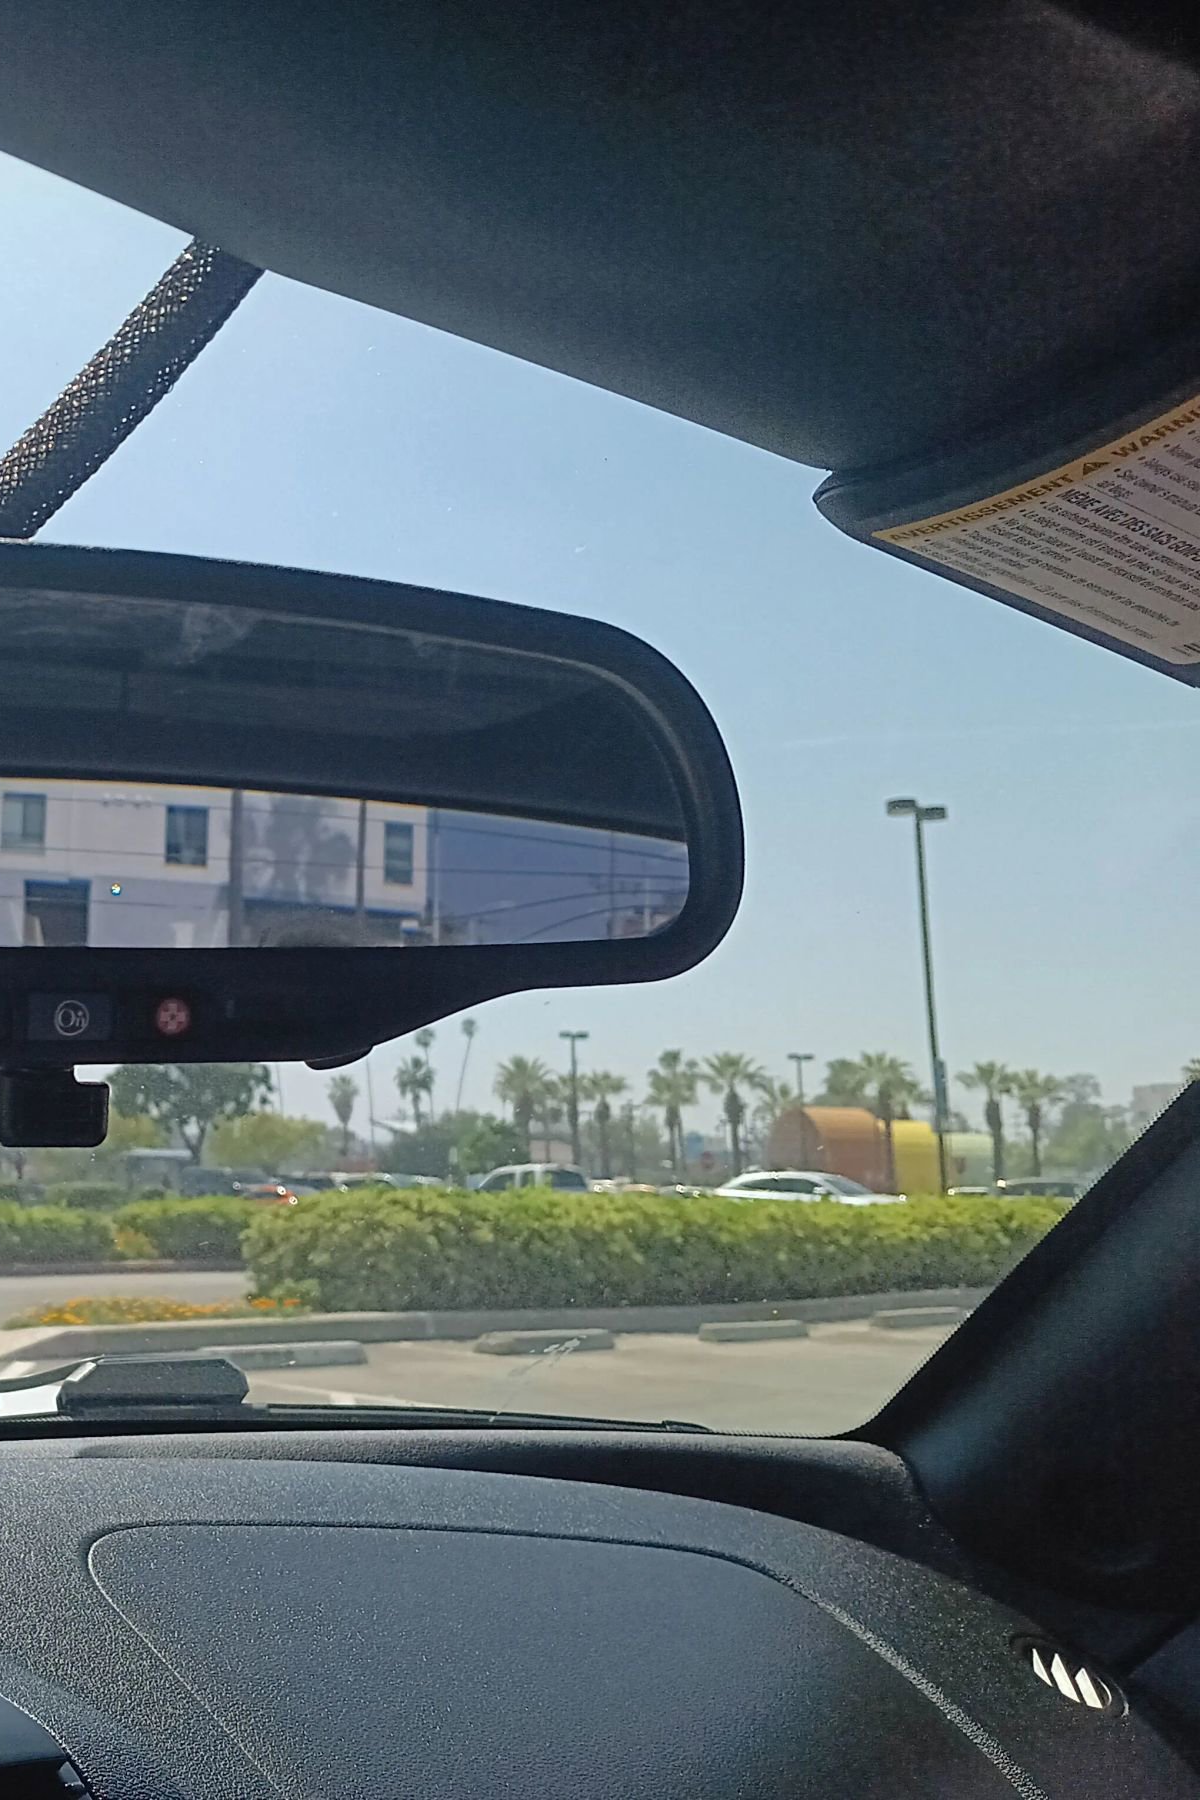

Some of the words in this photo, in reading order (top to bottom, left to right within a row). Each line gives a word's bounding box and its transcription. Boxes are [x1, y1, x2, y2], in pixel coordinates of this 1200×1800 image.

[1111, 404, 1200, 457] WARNI
[890, 474, 1074, 541] AVERTISSEMENT
[1086, 502, 1131, 523] AVEC
[1115, 515, 1153, 533] DES
[1136, 525, 1180, 546] SACS
